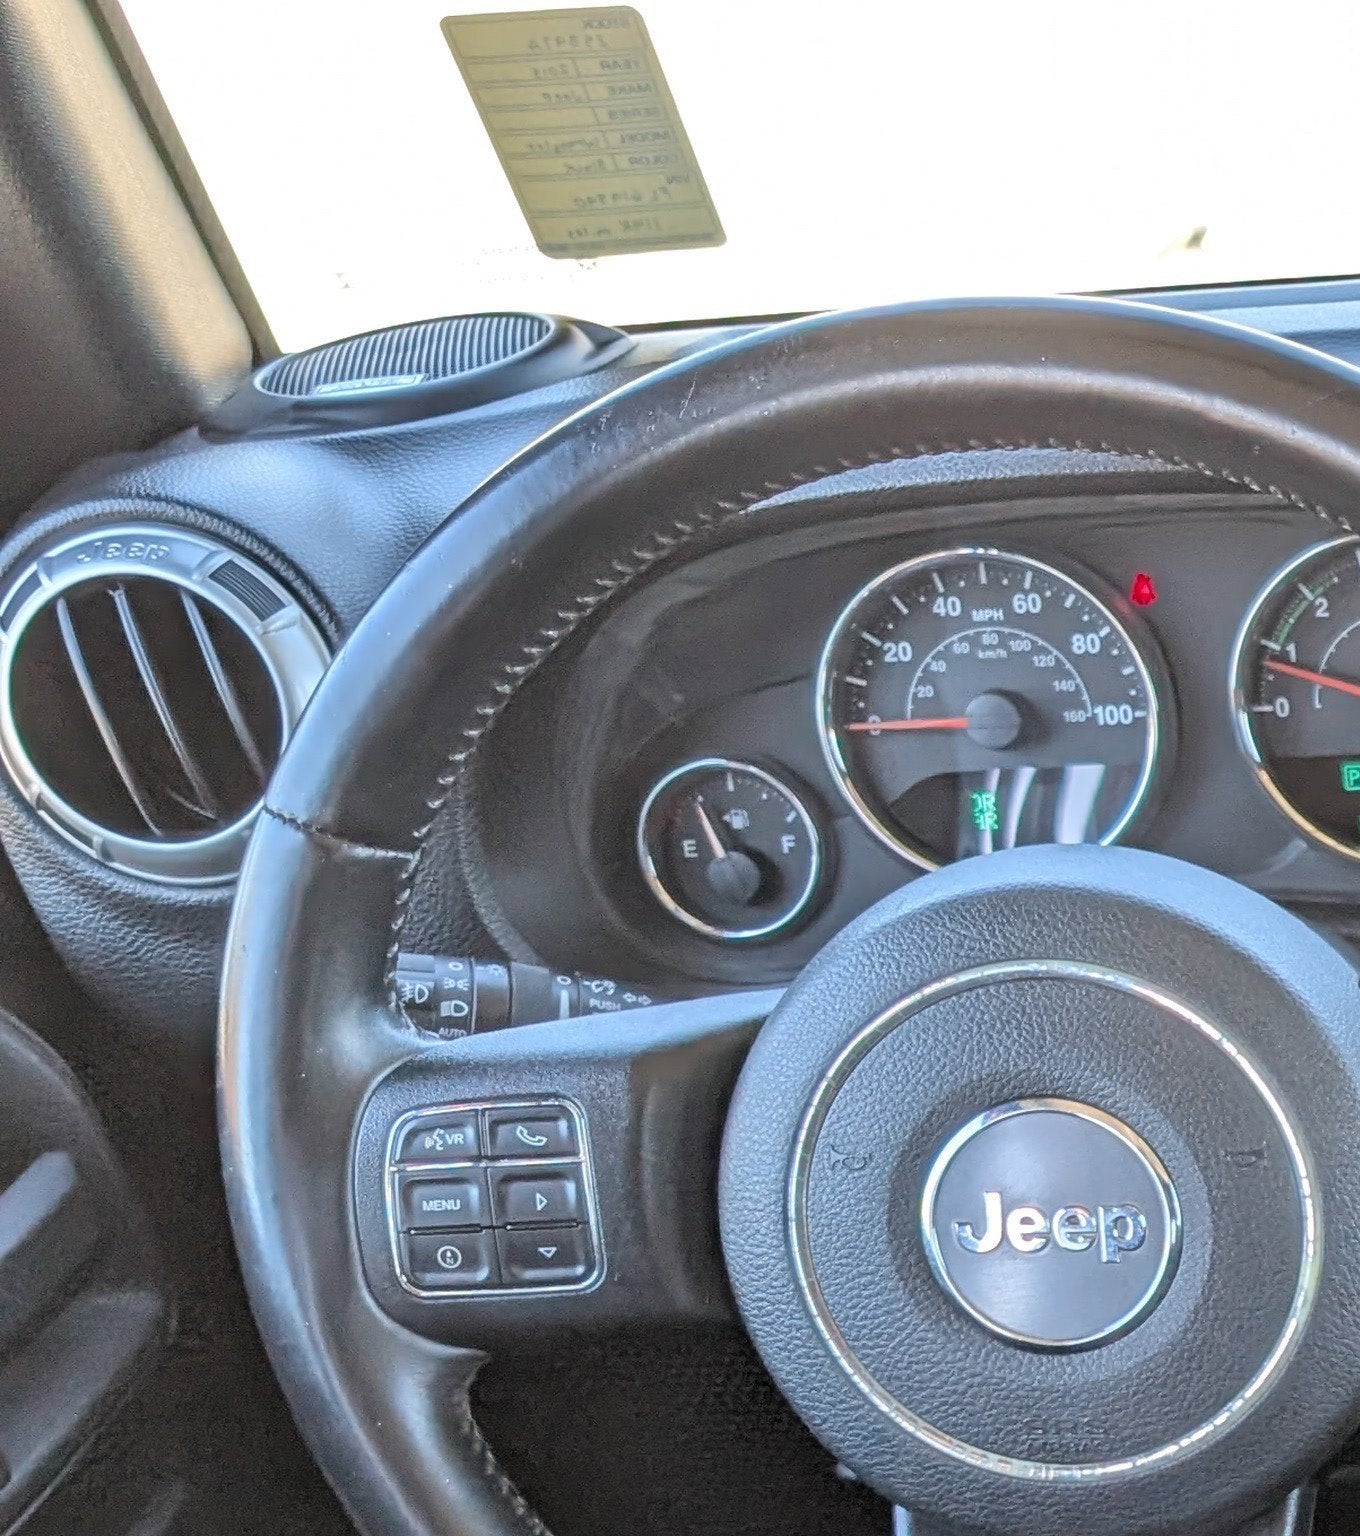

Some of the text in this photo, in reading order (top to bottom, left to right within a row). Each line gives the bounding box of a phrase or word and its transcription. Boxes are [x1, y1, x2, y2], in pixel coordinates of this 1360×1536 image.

[933, 597, 962, 617] 40
[1012, 593, 1042, 614] 60
[1315, 597, 1329, 618] 2
[972, 608, 1003, 621] MPH
[883, 642, 912, 662] 20
[1072, 633, 1101, 654] 80
[1286, 642, 1297, 663] 1
[1094, 704, 1133, 726] 100
[1275, 696, 1290, 718] 0
[683, 840, 698, 858] E
[782, 836, 796, 853] F
[422, 1199, 461, 1212] MENU
[953, 1190, 1147, 1264] Jeep
